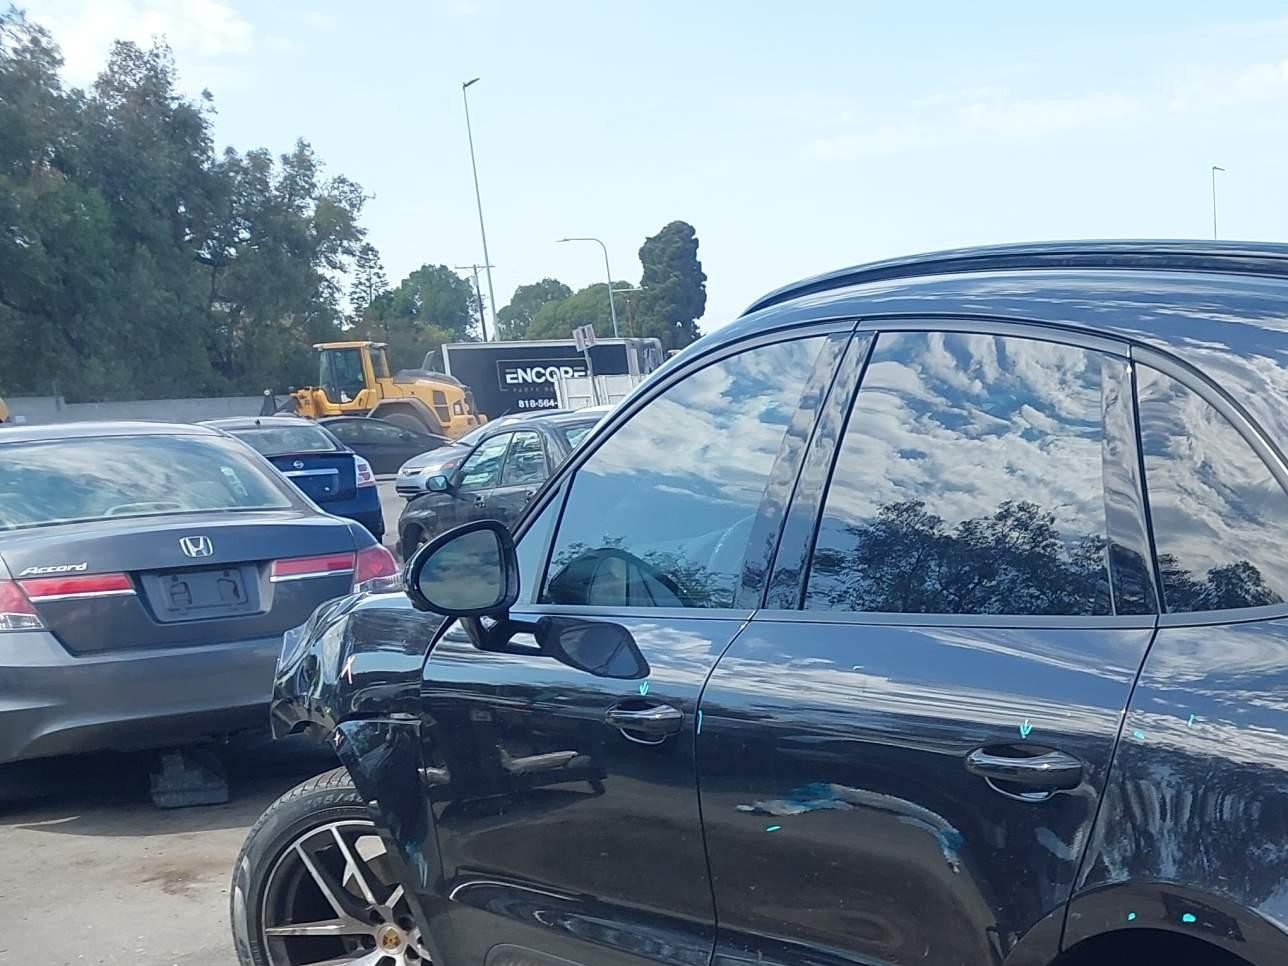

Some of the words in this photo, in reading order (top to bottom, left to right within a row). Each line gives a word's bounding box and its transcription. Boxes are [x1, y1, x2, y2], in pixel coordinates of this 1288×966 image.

[505, 366, 586, 384] ENCORE
[518, 398, 558, 408] 818-564-
[19, 561, 88, 576] Accord
